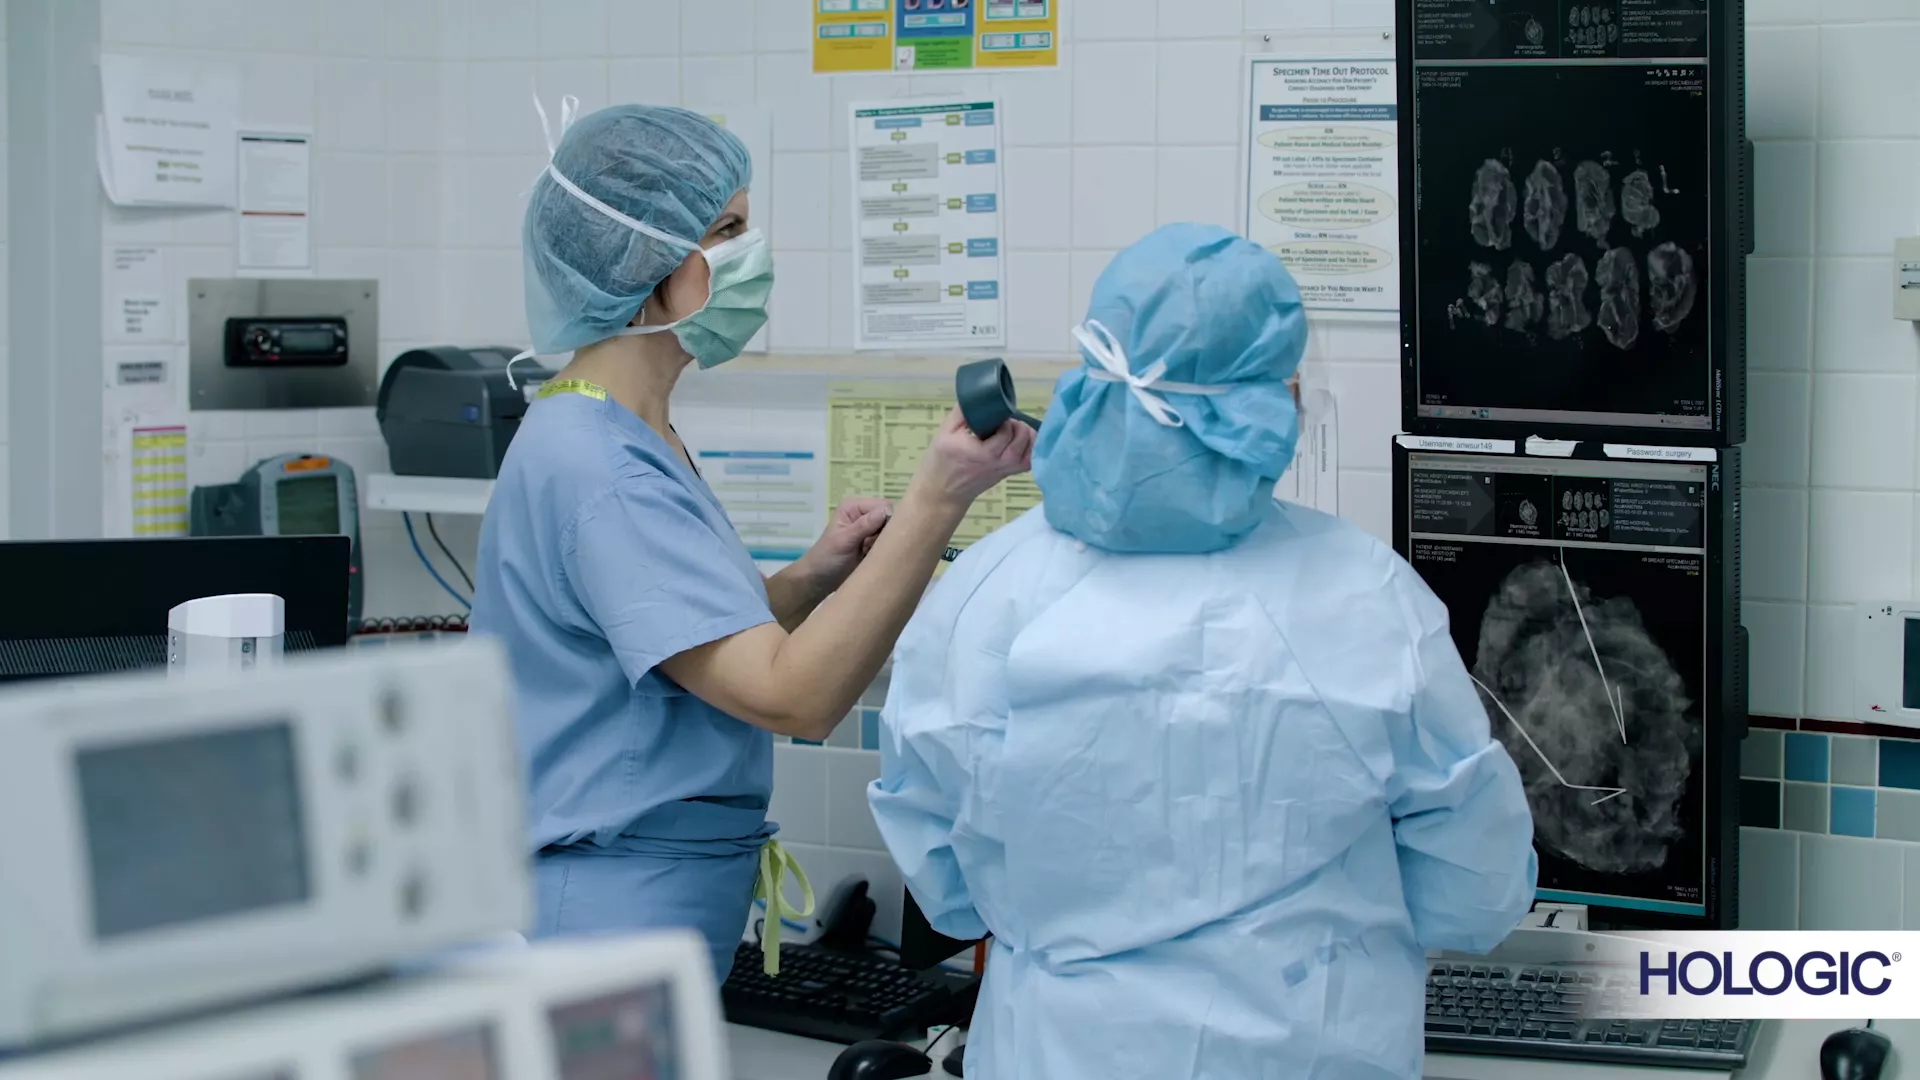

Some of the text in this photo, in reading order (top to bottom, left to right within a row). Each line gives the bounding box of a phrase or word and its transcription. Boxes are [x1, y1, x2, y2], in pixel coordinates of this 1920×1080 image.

[1312, 67, 1330, 75] TIME
[1332, 67, 1348, 75] OUT
[1350, 67, 1389, 75] PROTOCOL
[1419, 439, 1454, 448] Username:
[1627, 448, 1663, 456] Password:
